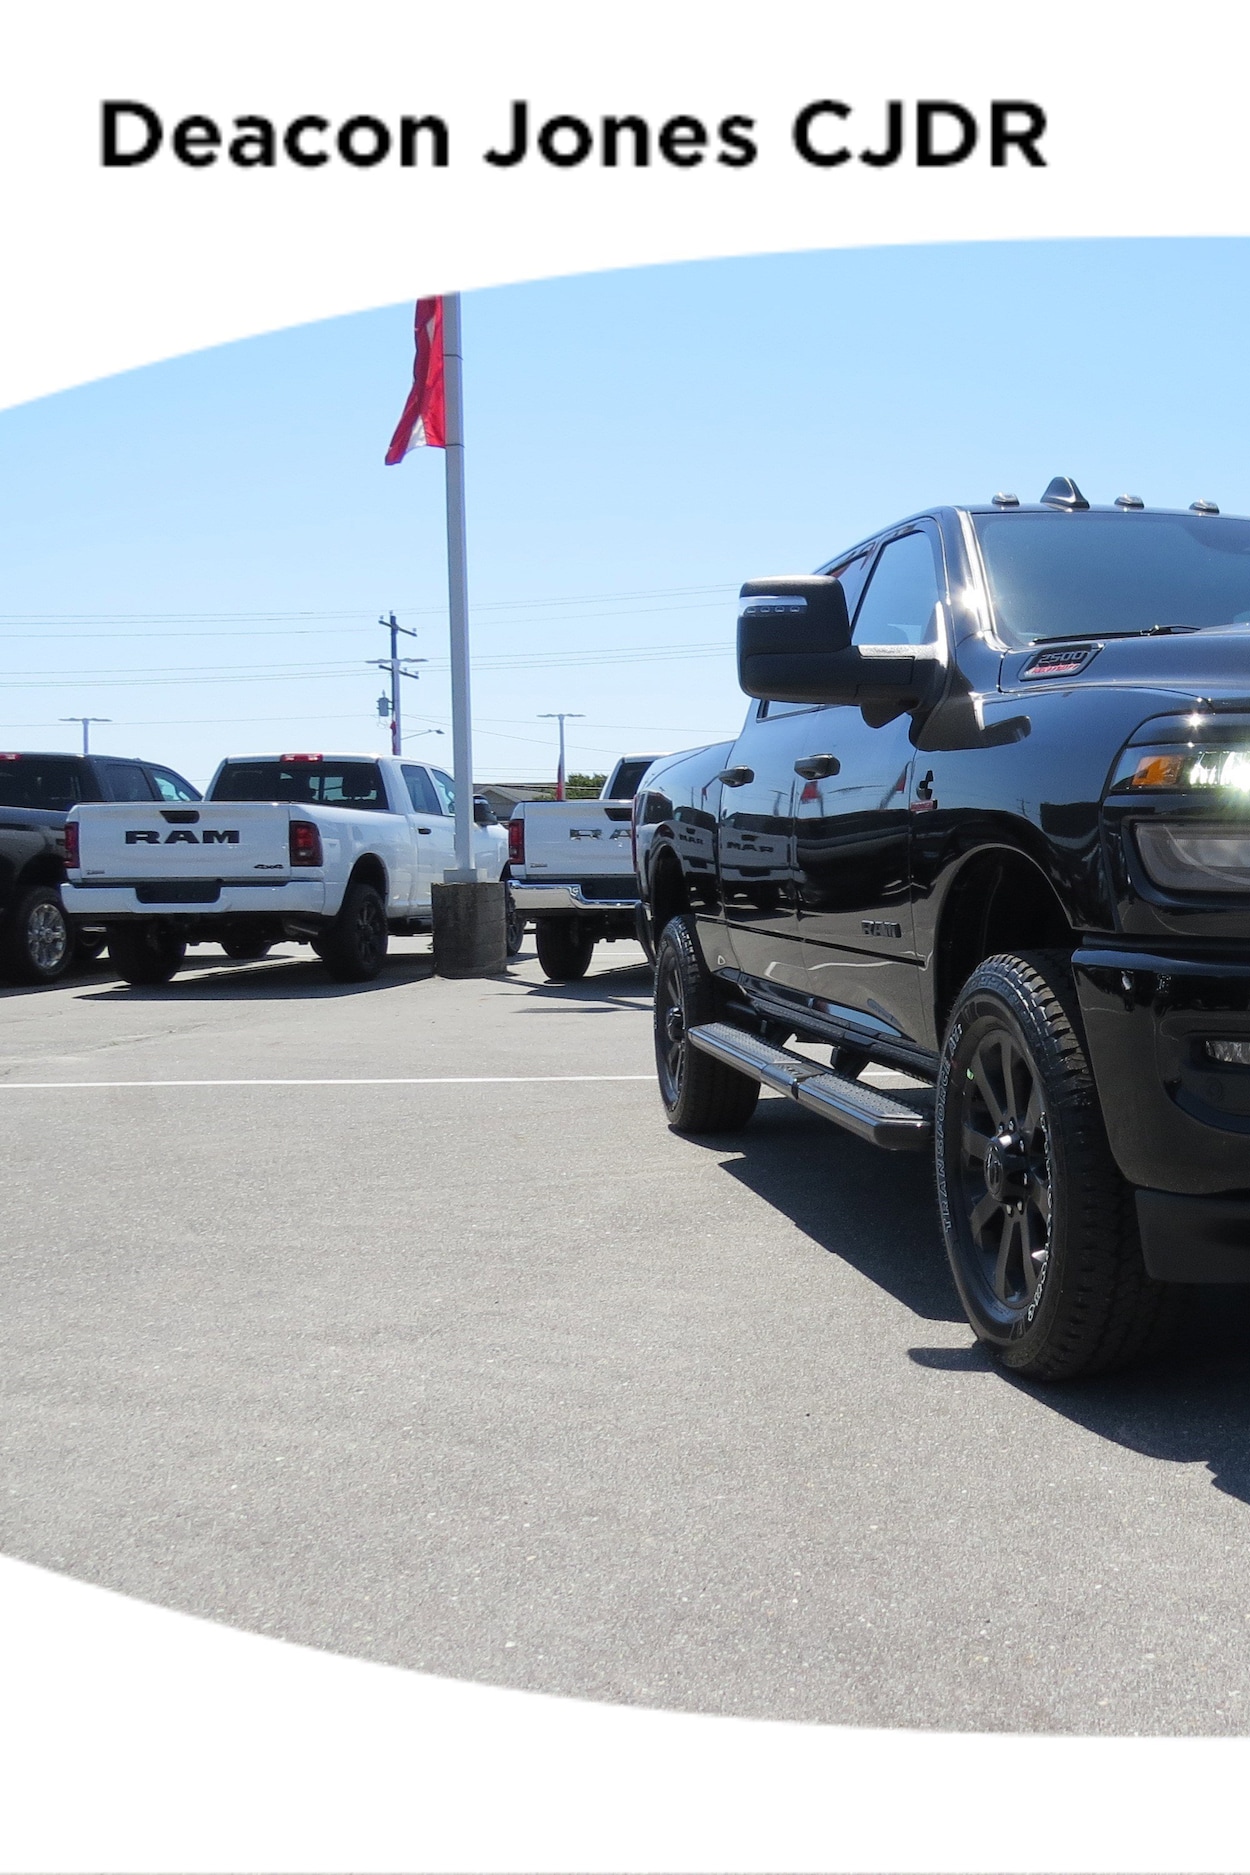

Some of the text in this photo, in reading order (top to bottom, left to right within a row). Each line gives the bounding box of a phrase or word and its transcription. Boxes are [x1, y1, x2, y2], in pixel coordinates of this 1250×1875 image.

[1038, 651, 1085, 664] 2500
[125, 830, 240, 844] RAM
[569, 828, 632, 841] RA
[861, 920, 902, 938] RAM
